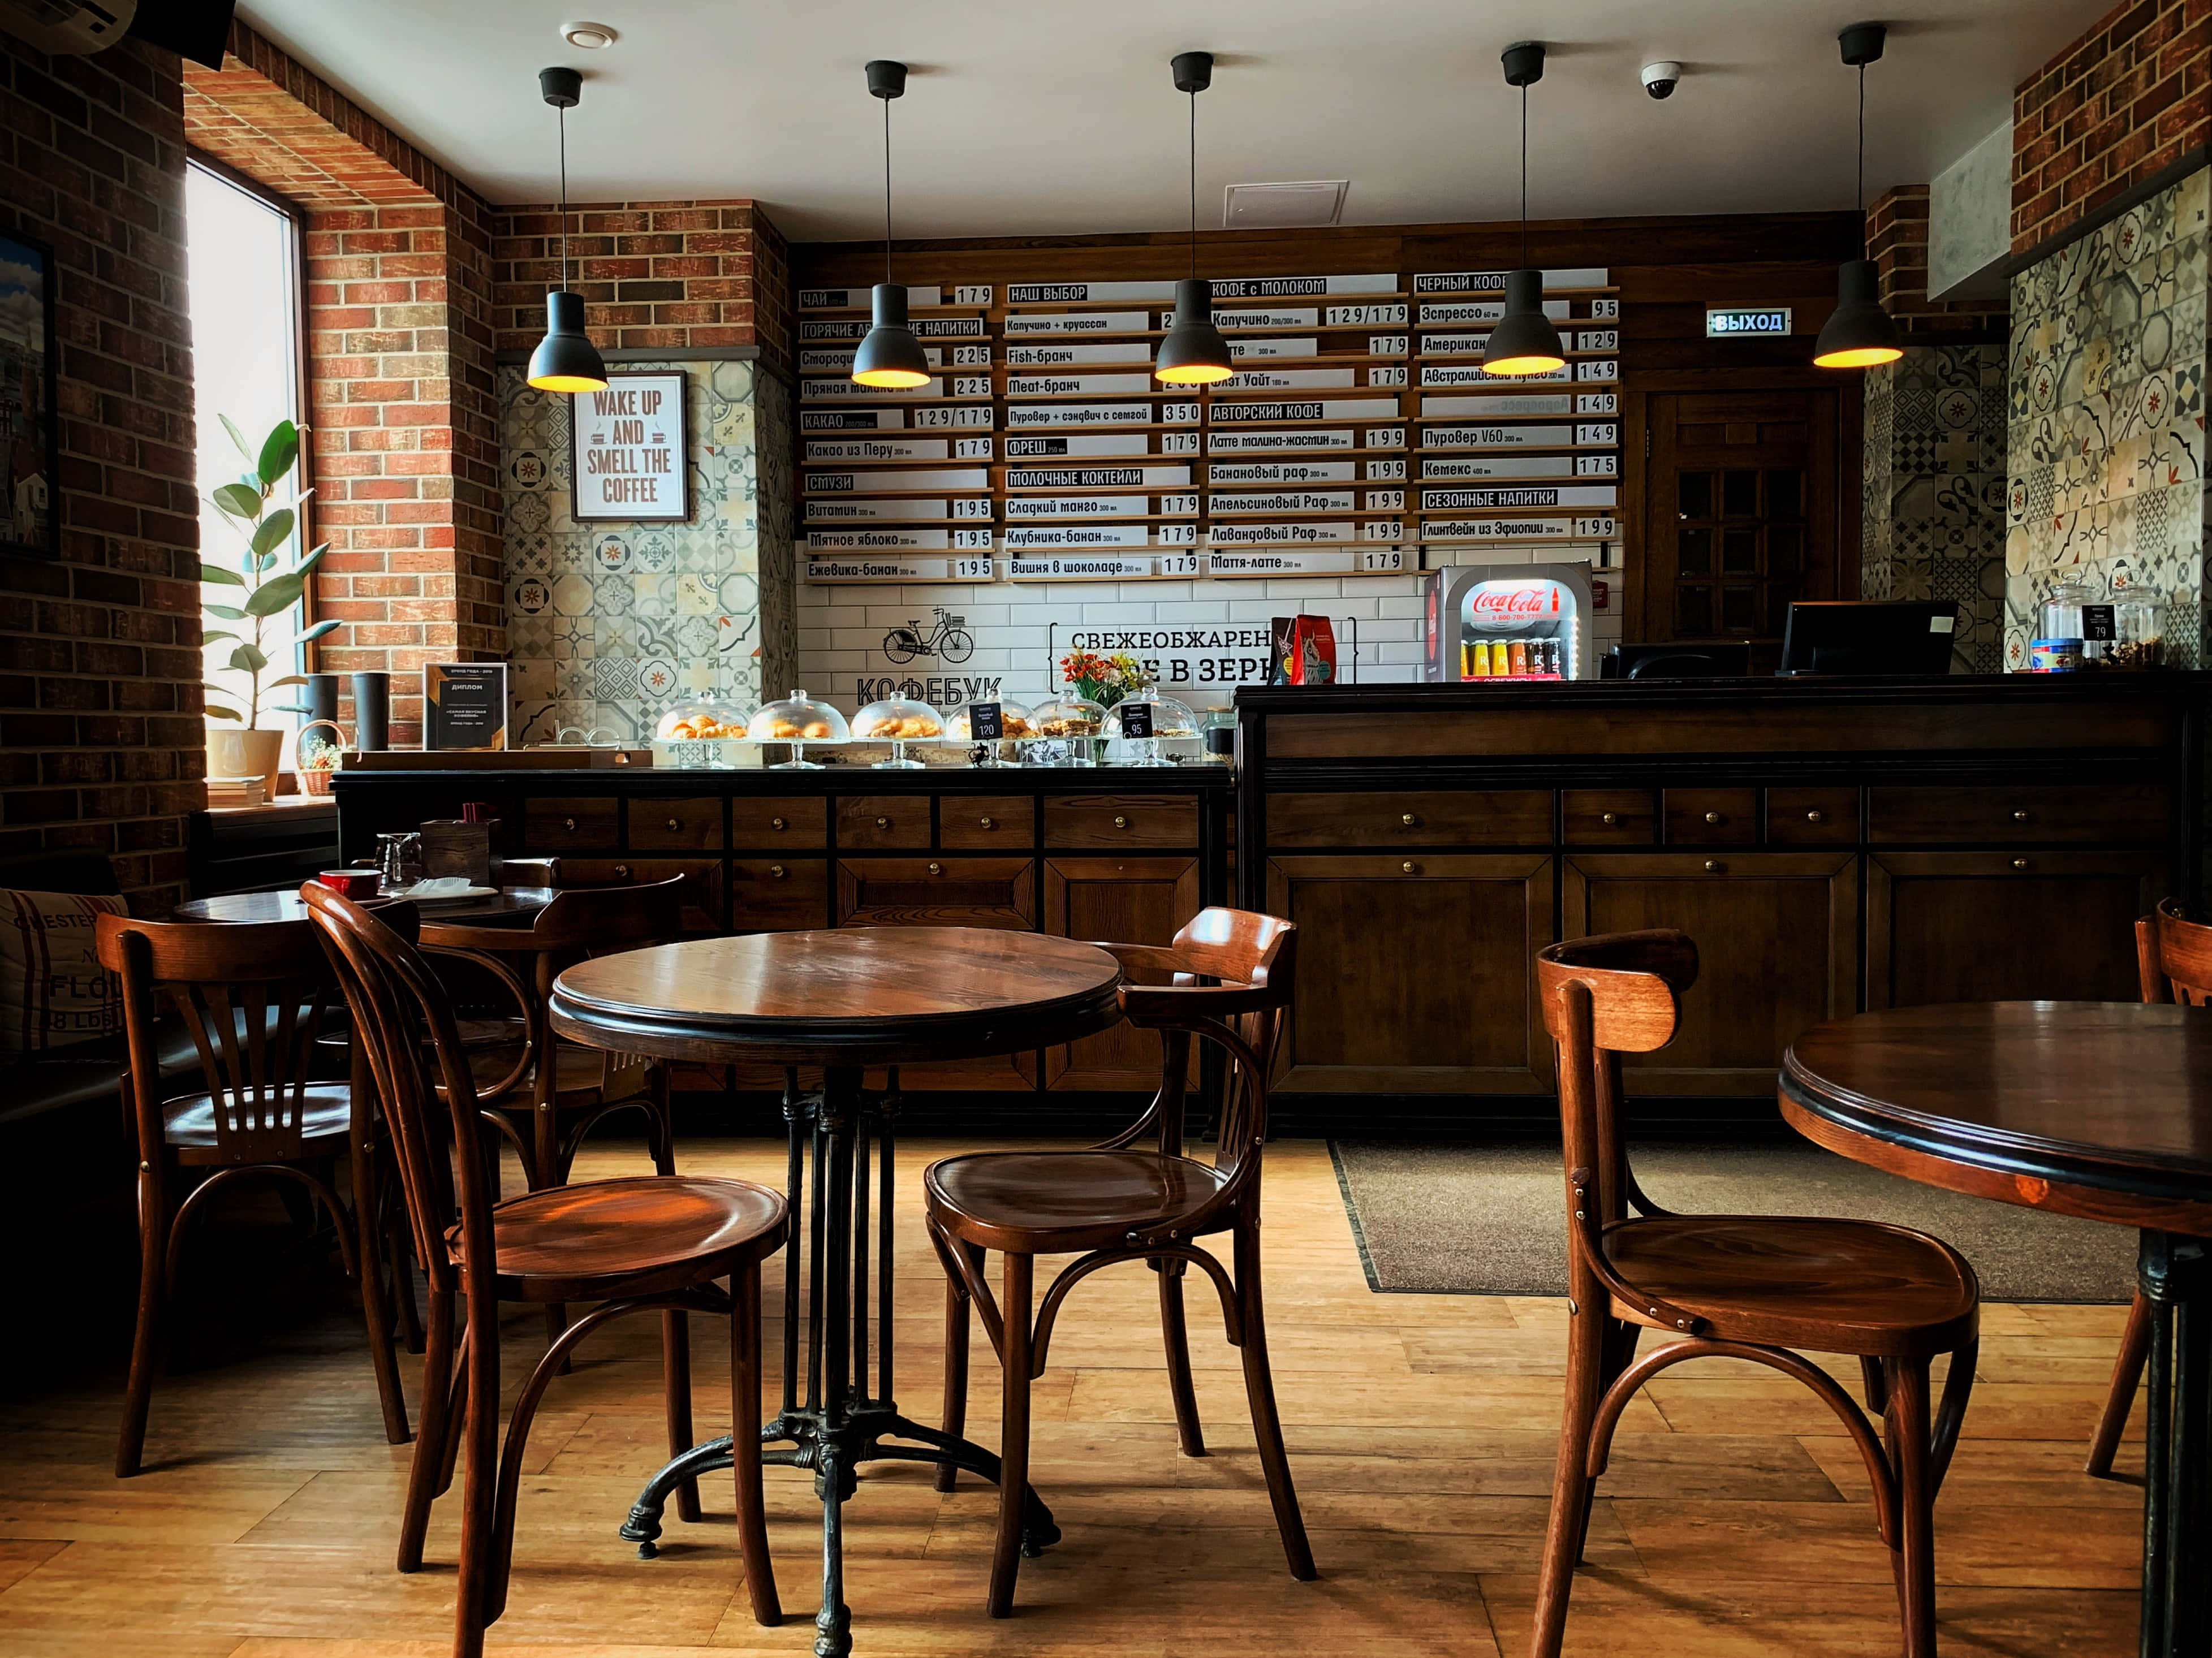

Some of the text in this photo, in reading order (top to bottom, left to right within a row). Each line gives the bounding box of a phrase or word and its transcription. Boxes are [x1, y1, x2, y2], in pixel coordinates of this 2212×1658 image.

[1213, 283, 1245, 296] КОФЕ
[1261, 280, 1324, 295] МОЛОКОМ
[1419, 274, 1469, 291] ЧЕРНЫЙ
[804, 288, 990, 306] ЧАЙ 179
[1012, 287, 1085, 301] НАШ ВЫБОР
[1213, 313, 1269, 329] Капучино
[1330, 306, 1405, 323] 129/179
[1422, 308, 1482, 322] Эспрессо
[1595, 301, 1616, 316] 95
[804, 322, 853, 337] ГОРЯЧИЕ
[926, 321, 978, 335] НАПИТКИ
[1007, 319, 1051, 333] Капучино
[1063, 319, 1107, 331] круассан
[1715, 314, 1782, 331] ВЫХОД
[1373, 338, 1406, 353] 179
[1424, 333, 1615, 353] Американ 129
[957, 349, 988, 363] 225
[1009, 349, 1072, 364] Fish-бранч
[1244, 373, 1270, 387] Уайт
[1373, 369, 1405, 384] 179
[1581, 363, 1615, 378] 149
[804, 382, 847, 397] Пряная
[957, 379, 989, 394] 225
[1009, 380, 1080, 394] Meat-бранч
[593, 390, 661, 416] WAKE UP
[1581, 395, 1614, 410] 149
[805, 414, 843, 428] КАКАО
[917, 408, 991, 426] 129/179
[1011, 411, 1050, 424] Пуровер
[1063, 411, 1101, 423] сэндвич
[1166, 405, 1198, 420] 350
[1213, 404, 1320, 420] АВТОРСКИЙ КОФЕ
[613, 420, 644, 444] AND
[1210, 435, 1237, 448] Латте
[1242, 435, 1329, 447] малина-жасмин
[1370, 430, 1402, 446] 199
[1425, 430, 1477, 446] Пуровер
[1482, 430, 1502, 442] V60
[1580, 426, 1613, 441] 149
[808, 444, 843, 457] Какао
[847, 446, 860, 455] из
[864, 443, 892, 459] Перу
[959, 440, 990, 456] 179
[1010, 441, 1046, 454] ФРЕШ
[1165, 435, 1197, 451] 179
[588, 448, 671, 474] SMELL THE
[1425, 463, 1471, 476] Кемекс
[1580, 458, 1613, 473] 175
[1010, 469, 1140, 486] МОЛОЧНЫЕ КОКТЕЙЛИ
[1211, 465, 1279, 479] Банановый
[1283, 467, 1308, 481] раф
[1370, 463, 1404, 477] 199
[603, 477, 657, 503] COFFEE
[810, 476, 851, 489] СМУЗИ
[1008, 500, 1056, 516] Сладкий
[1061, 502, 1098, 512] манго
[1165, 496, 1197, 512] 179
[1211, 496, 1300, 510] Апельсиновый
[1304, 495, 1329, 510] Раф
[1370, 492, 1402, 508] 199
[1428, 491, 1554, 507] СЕЗОННЫЕ НАПИТКИ
[808, 503, 857, 516] Витамин
[957, 501, 988, 516] 195
[1008, 530, 1101, 546] Клубника-банан
[1163, 527, 1194, 542] 179
[1212, 526, 1288, 543] Лавандовый
[1292, 526, 1317, 541] Раф
[1368, 523, 1400, 538] 199
[1423, 522, 1475, 536] Глинтвейн
[1479, 525, 1491, 534] из
[1495, 521, 1543, 537] Эфиопии
[1580, 519, 1612, 535] 199
[810, 533, 854, 546] Мятное
[859, 533, 898, 545] яблоко
[957, 532, 989, 546] 195
[809, 563, 898, 576] Ежевика-банан
[959, 561, 990, 575] 195
[1012, 561, 1049, 573] Вишня
[1053, 560, 1059, 572] в
[1064, 561, 1122, 575] шоколаде
[1165, 557, 1197, 572] 179
[1367, 554, 1400, 568] 179
[1072, 629, 1271, 650] СВЕЖЕОБЖАРЕН
[2095, 627, 2106, 637] 79
[1170, 659, 1189, 682] В
[979, 724, 994, 735] 120
[1132, 724, 1142, 734] 95
